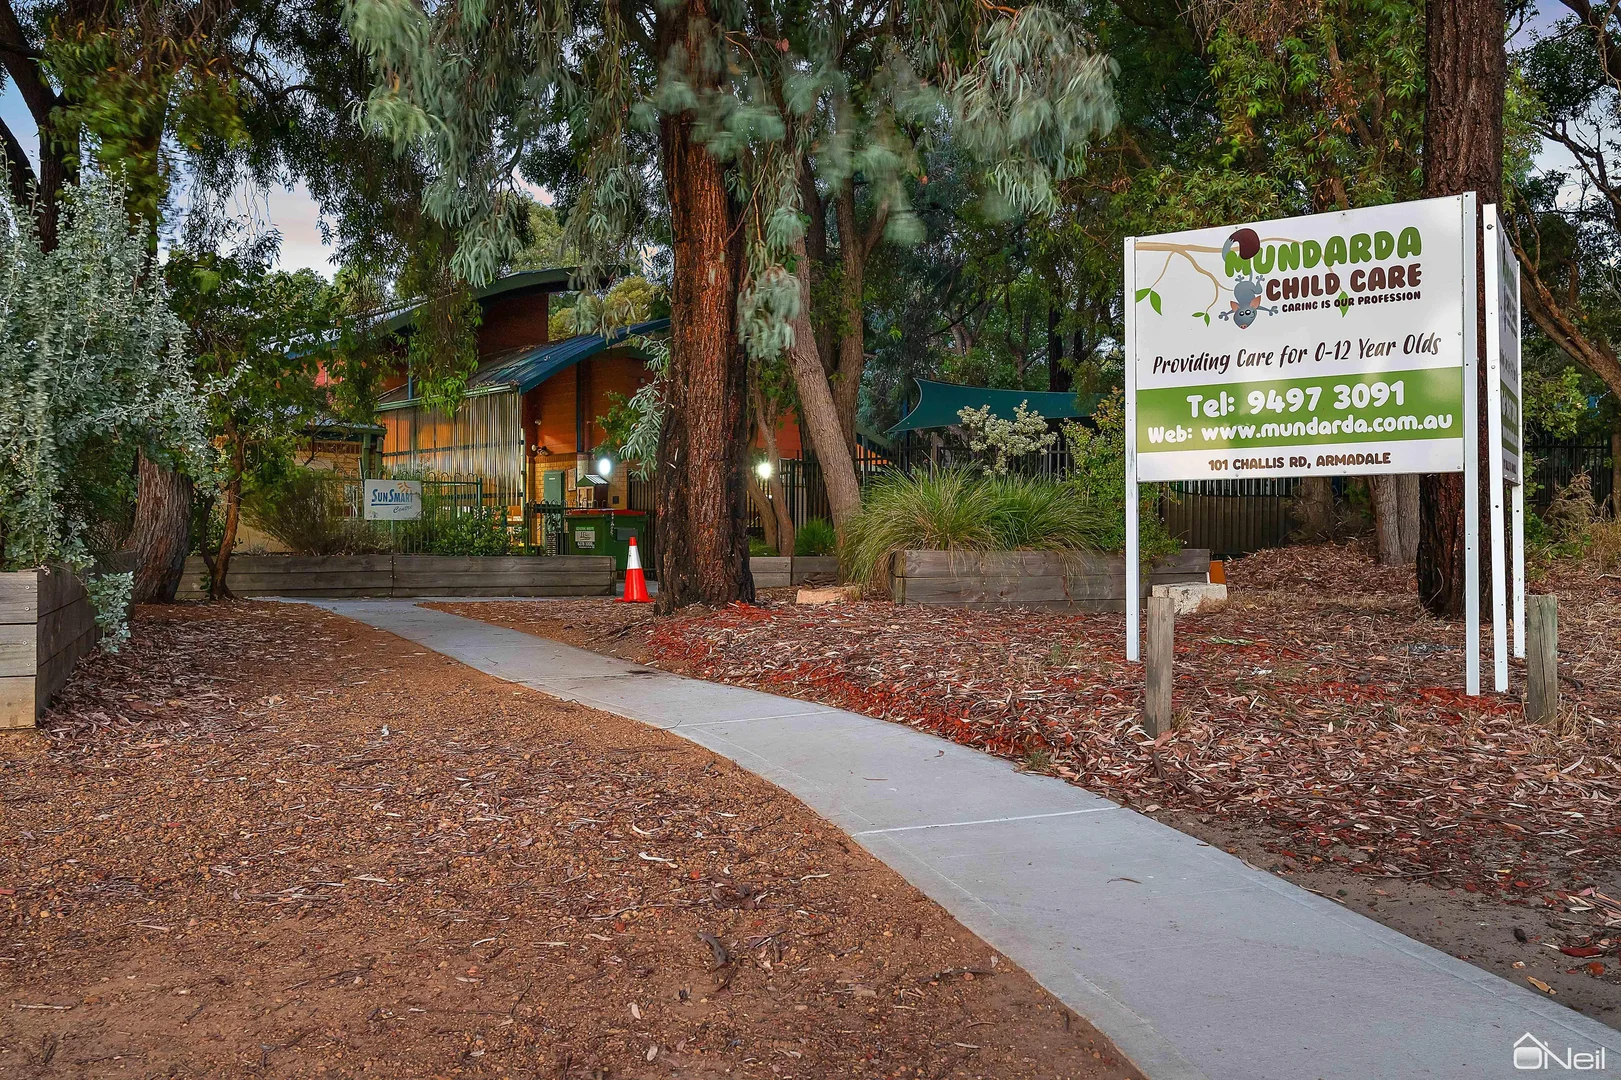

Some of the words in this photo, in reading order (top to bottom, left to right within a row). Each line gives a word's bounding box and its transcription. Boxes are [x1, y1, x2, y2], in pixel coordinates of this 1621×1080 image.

[1225, 226, 1422, 277] MUNDARDA
[1265, 272, 1341, 301] CHILD
[1350, 263, 1422, 292] CARE
[1281, 300, 1318, 313] CARING
[1321, 299, 1331, 309] IS
[1335, 296, 1355, 308] OUR
[1357, 290, 1421, 306] PROFESSION
[1152, 352, 1231, 375] Providing
[1236, 348, 1275, 368] Care
[1279, 345, 1308, 368] for
[1314, 340, 1352, 362] 0-12
[1358, 338, 1397, 360] Year
[1402, 332, 1442, 356] Olds
[1186, 391, 1236, 418] Tel:
[1247, 386, 1323, 415] 9497
[1333, 380, 1405, 410] 3091
[1147, 424, 1193, 444] Web:
[1201, 413, 1453, 442] www.mundarda.com.au
[1208, 459, 1229, 471] 101
[1232, 456, 1285, 470] CHALLIS
[1289, 455, 1312, 470] RD,
[1315, 452, 1391, 467] ARMADALE
